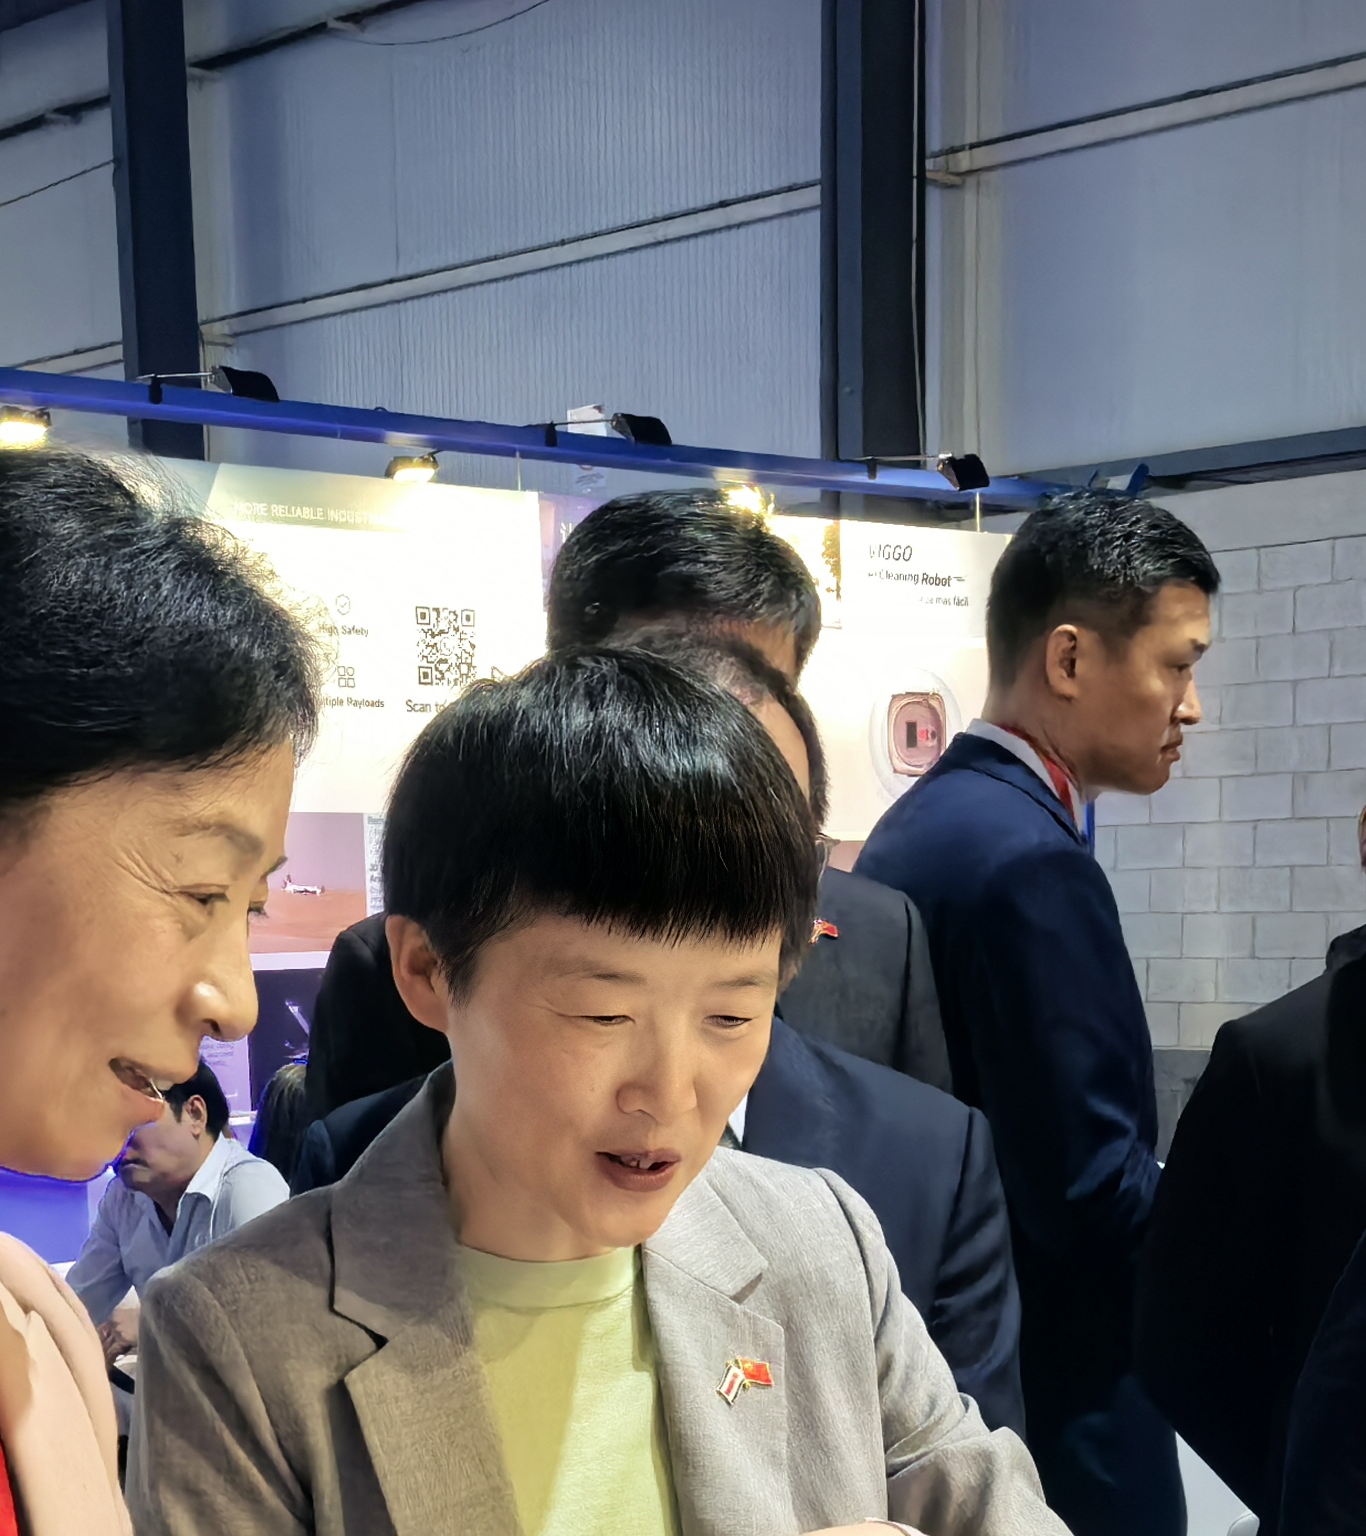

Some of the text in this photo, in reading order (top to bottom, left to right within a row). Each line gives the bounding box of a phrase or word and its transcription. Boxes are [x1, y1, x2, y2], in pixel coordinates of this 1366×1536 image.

[271, 504, 325, 520] RELIABLE
[921, 572, 952, 587] Robot
[341, 625, 369, 637] Safety
[346, 697, 385, 710] Payloads
[405, 699, 432, 713] Scan
